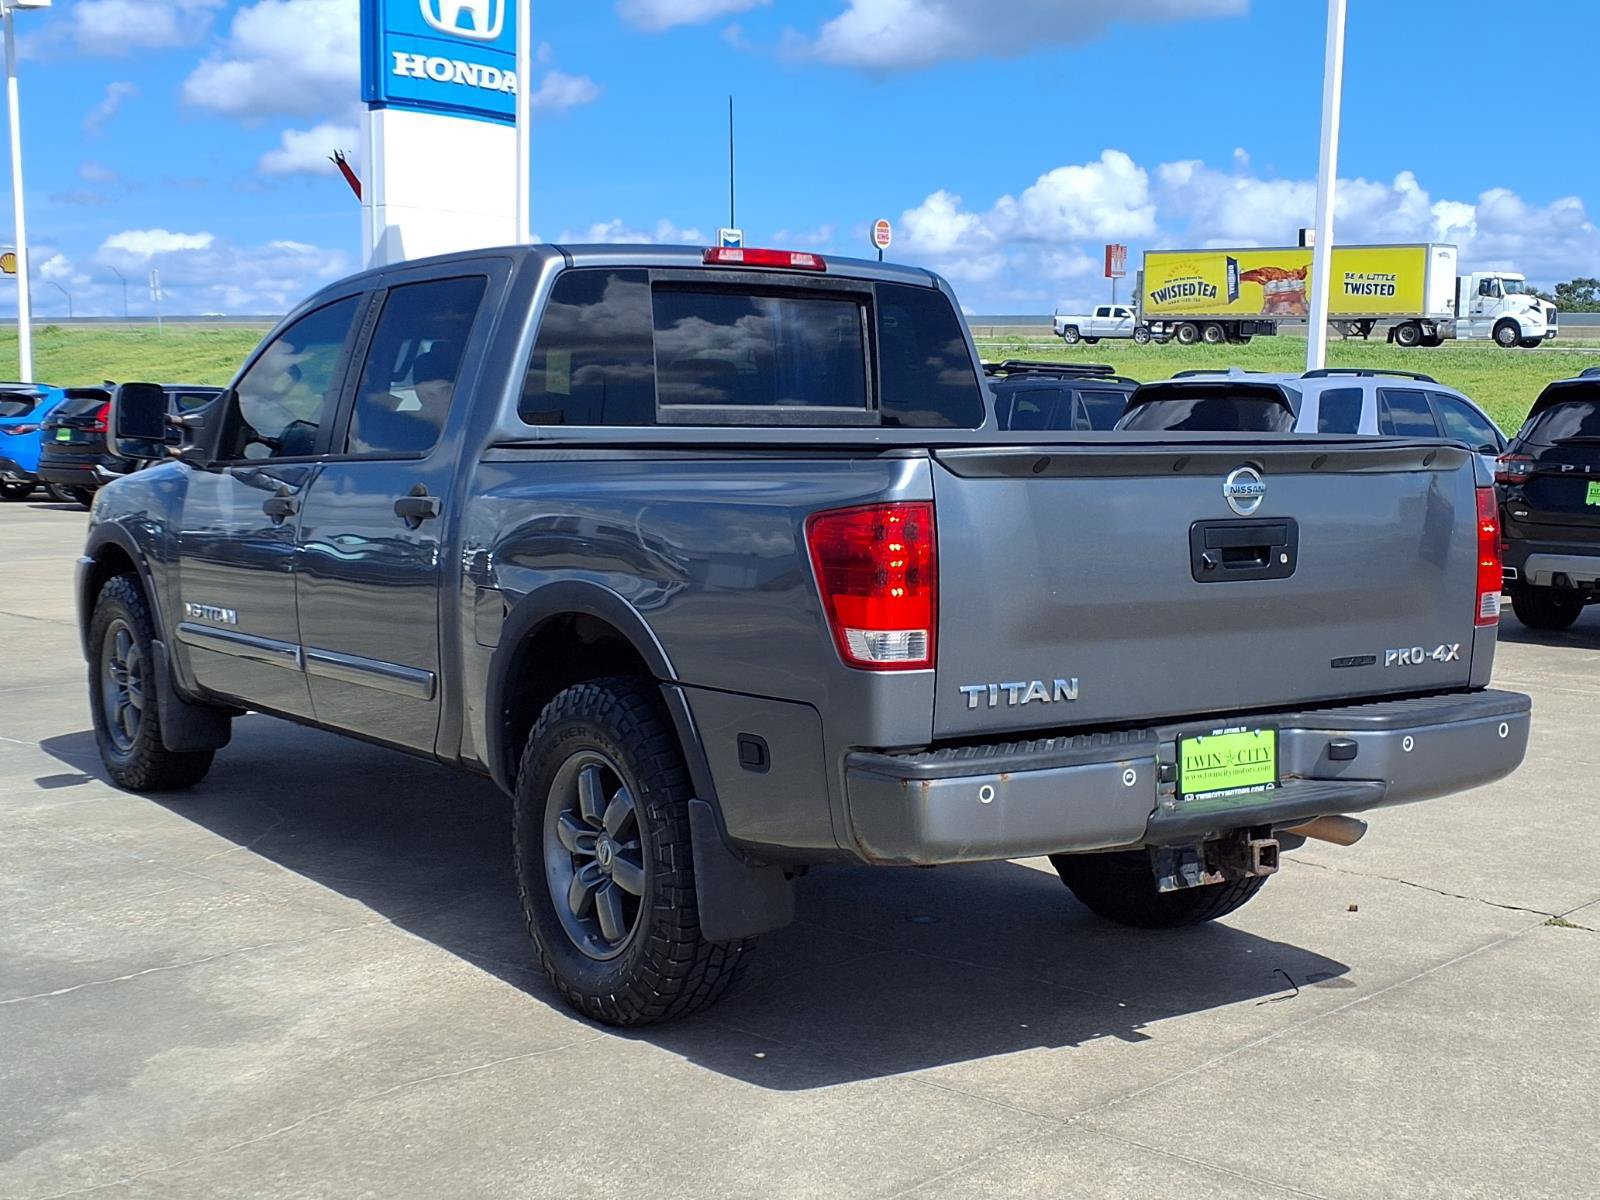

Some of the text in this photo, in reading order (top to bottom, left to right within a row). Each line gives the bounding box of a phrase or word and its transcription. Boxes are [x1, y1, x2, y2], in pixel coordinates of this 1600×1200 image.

[392, 51, 517, 95] HONDA
[1344, 272, 1355, 280] BE
[1366, 273, 1396, 281] LITTLE
[1150, 282, 1195, 305] TWISTED
[1197, 281, 1217, 299] TEA
[1343, 282, 1395, 297] TWISTED
[1230, 485, 1265, 494] NISSAN
[1384, 643, 1460, 667] PRO-4X
[959, 678, 1079, 708] TITAN
[1184, 746, 1272, 770] TWIN CITY
